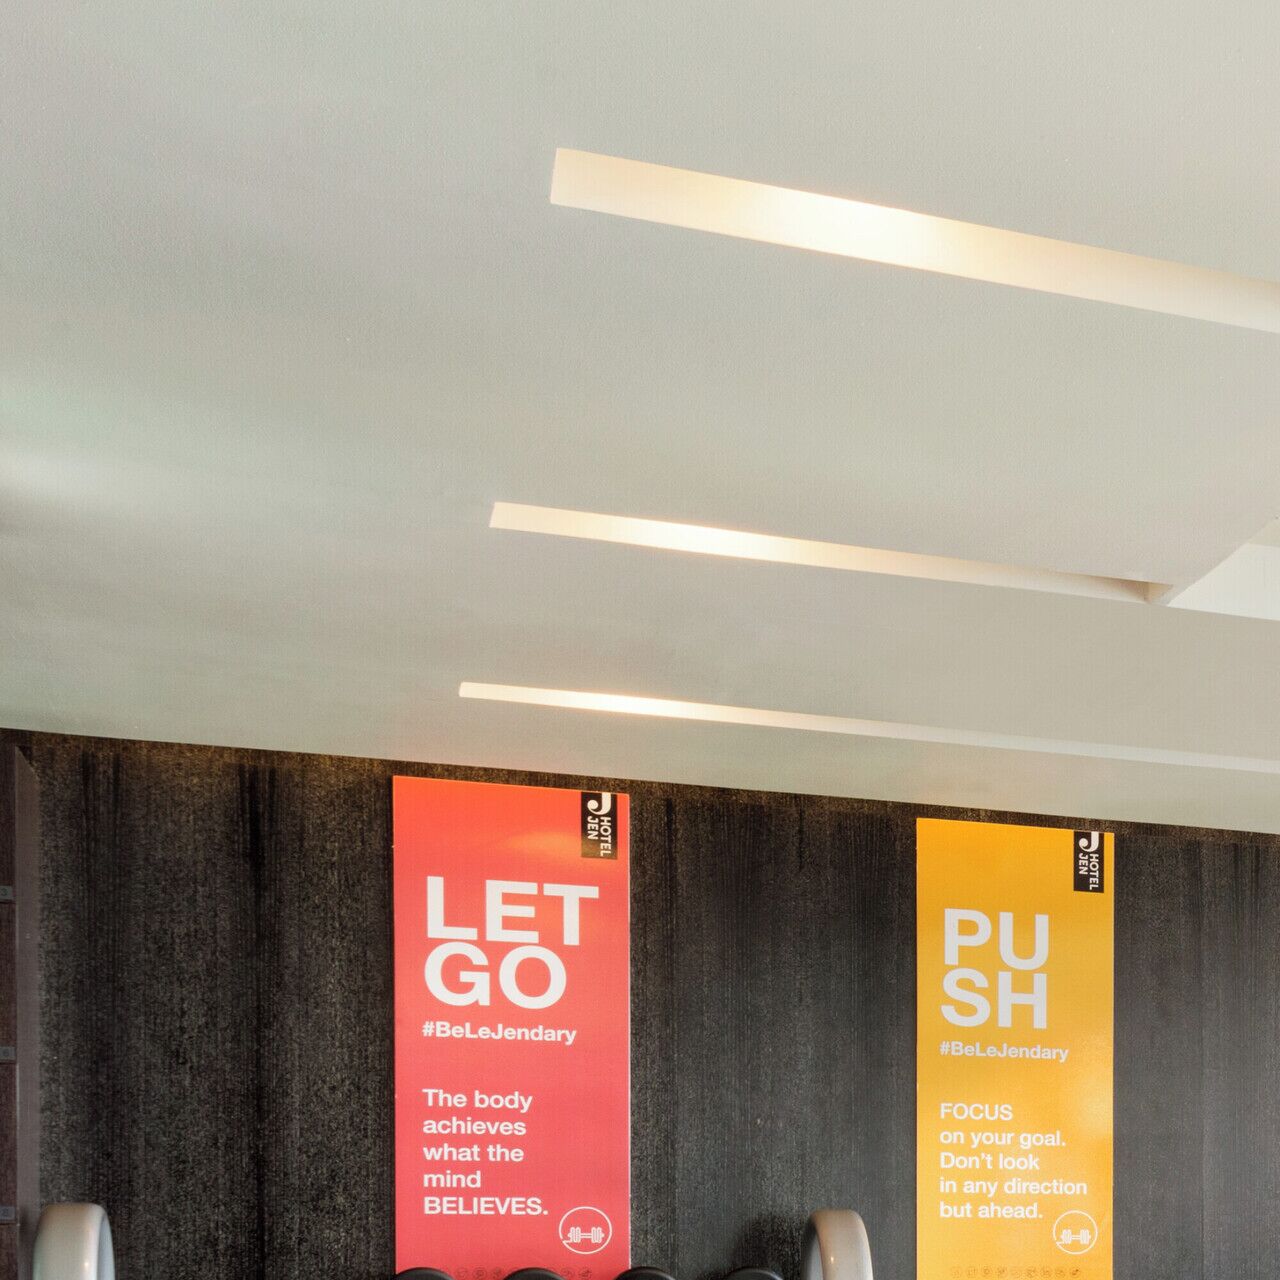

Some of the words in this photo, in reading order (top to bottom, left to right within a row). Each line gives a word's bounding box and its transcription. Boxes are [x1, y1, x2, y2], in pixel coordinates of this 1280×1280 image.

[587, 816, 599, 840] JEN
[600, 816, 612, 857] HOTEL
[1079, 853, 1089, 875] JEN
[1089, 853, 1099, 890] HOTEL
[426, 876, 599, 946] LET
[944, 908, 1049, 971] PU
[424, 941, 567, 1009] GO
[940, 967, 1047, 1029] SH
[422, 1021, 577, 1046] #BeLeJendary
[939, 1041, 1070, 1063] #BeLeJendary
[422, 1087, 468, 1108] The
[474, 1088, 533, 1113] body
[940, 1103, 1014, 1121] FOCUS
[422, 1115, 527, 1136] achieves
[939, 1131, 965, 1145] on
[970, 1131, 1015, 1149] your
[1019, 1130, 1066, 1150] goal.
[423, 1142, 481, 1162] what
[487, 1142, 524, 1163] the
[999, 1153, 1040, 1170] look
[423, 1169, 481, 1189] mind
[939, 1176, 957, 1194] in
[963, 1180, 999, 1198] any
[1003, 1178, 1088, 1195] direction
[423, 1196, 550, 1217] BELIEVES.
[939, 1201, 972, 1219] but
[978, 1202, 1043, 1219] ahead.
